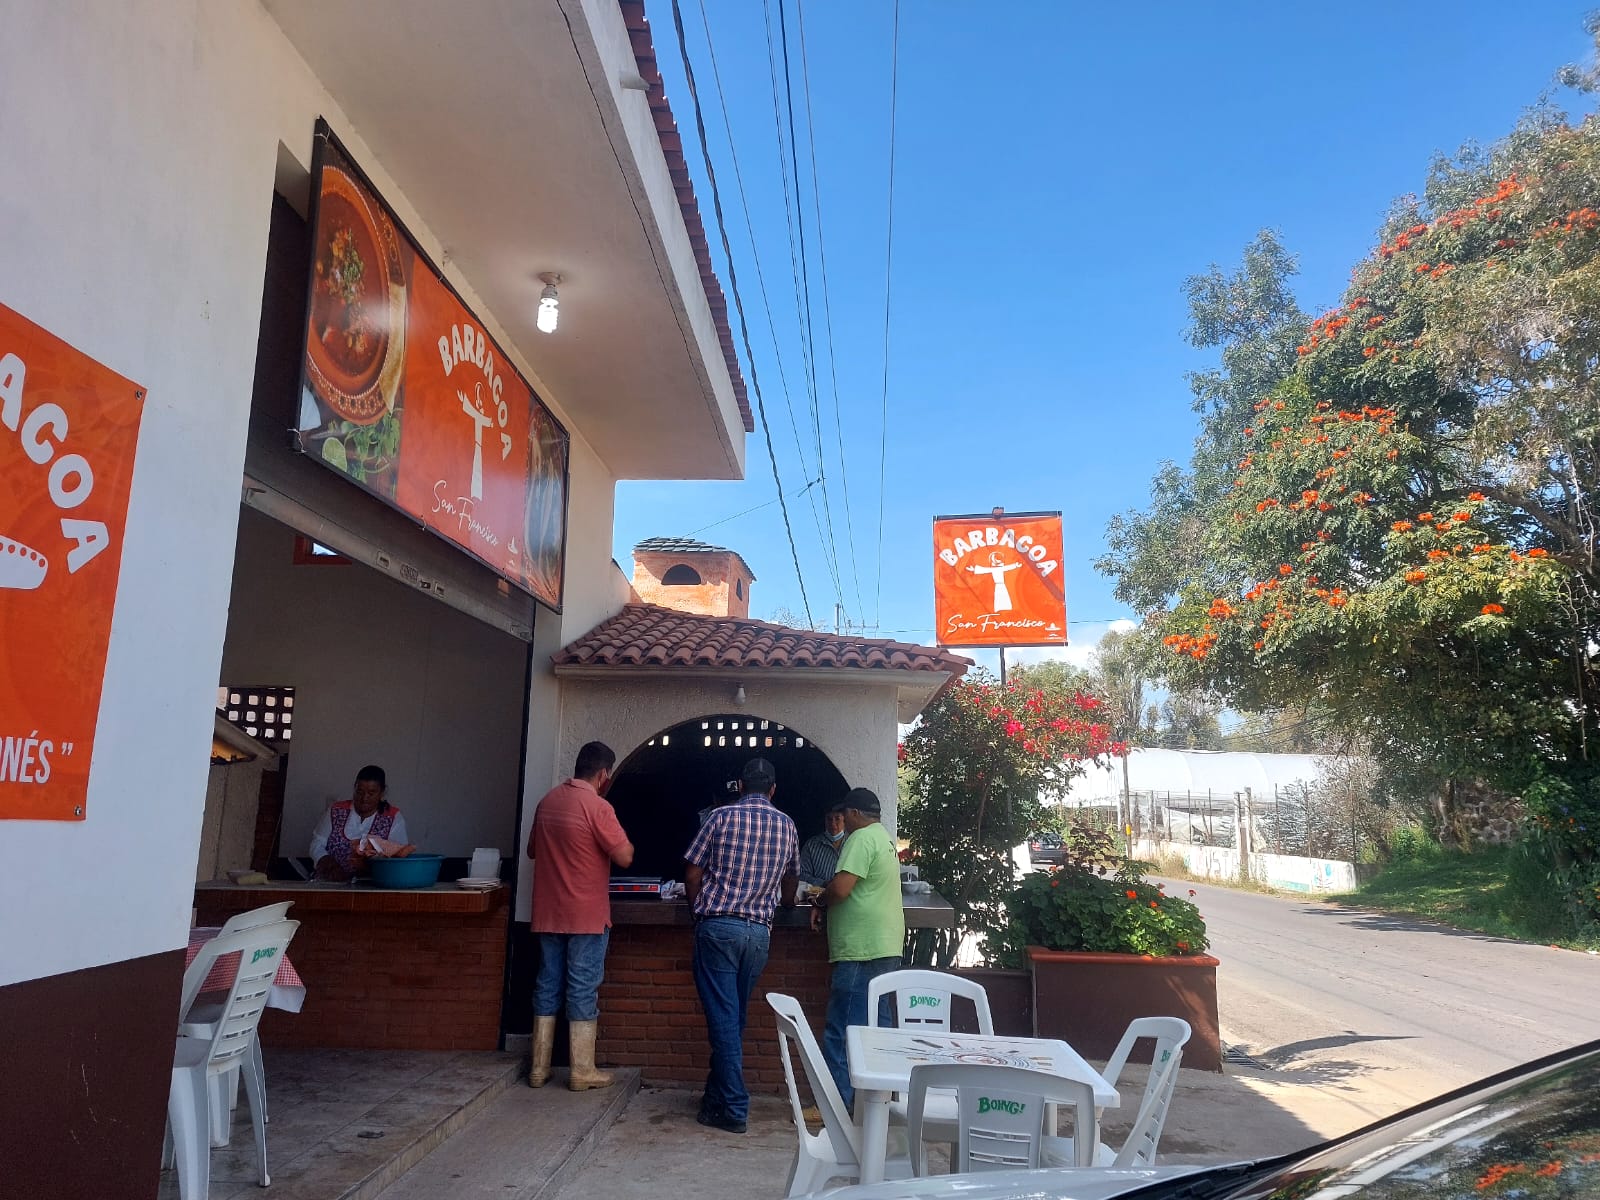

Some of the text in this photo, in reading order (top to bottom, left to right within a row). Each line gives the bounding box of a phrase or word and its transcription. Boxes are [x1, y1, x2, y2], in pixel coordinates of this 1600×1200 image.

[438, 324, 512, 461] BARBACOA
[432, 480, 457, 514] San
[939, 527, 1058, 577] BARBACOA
[947, 613, 1046, 633] San Francisco
